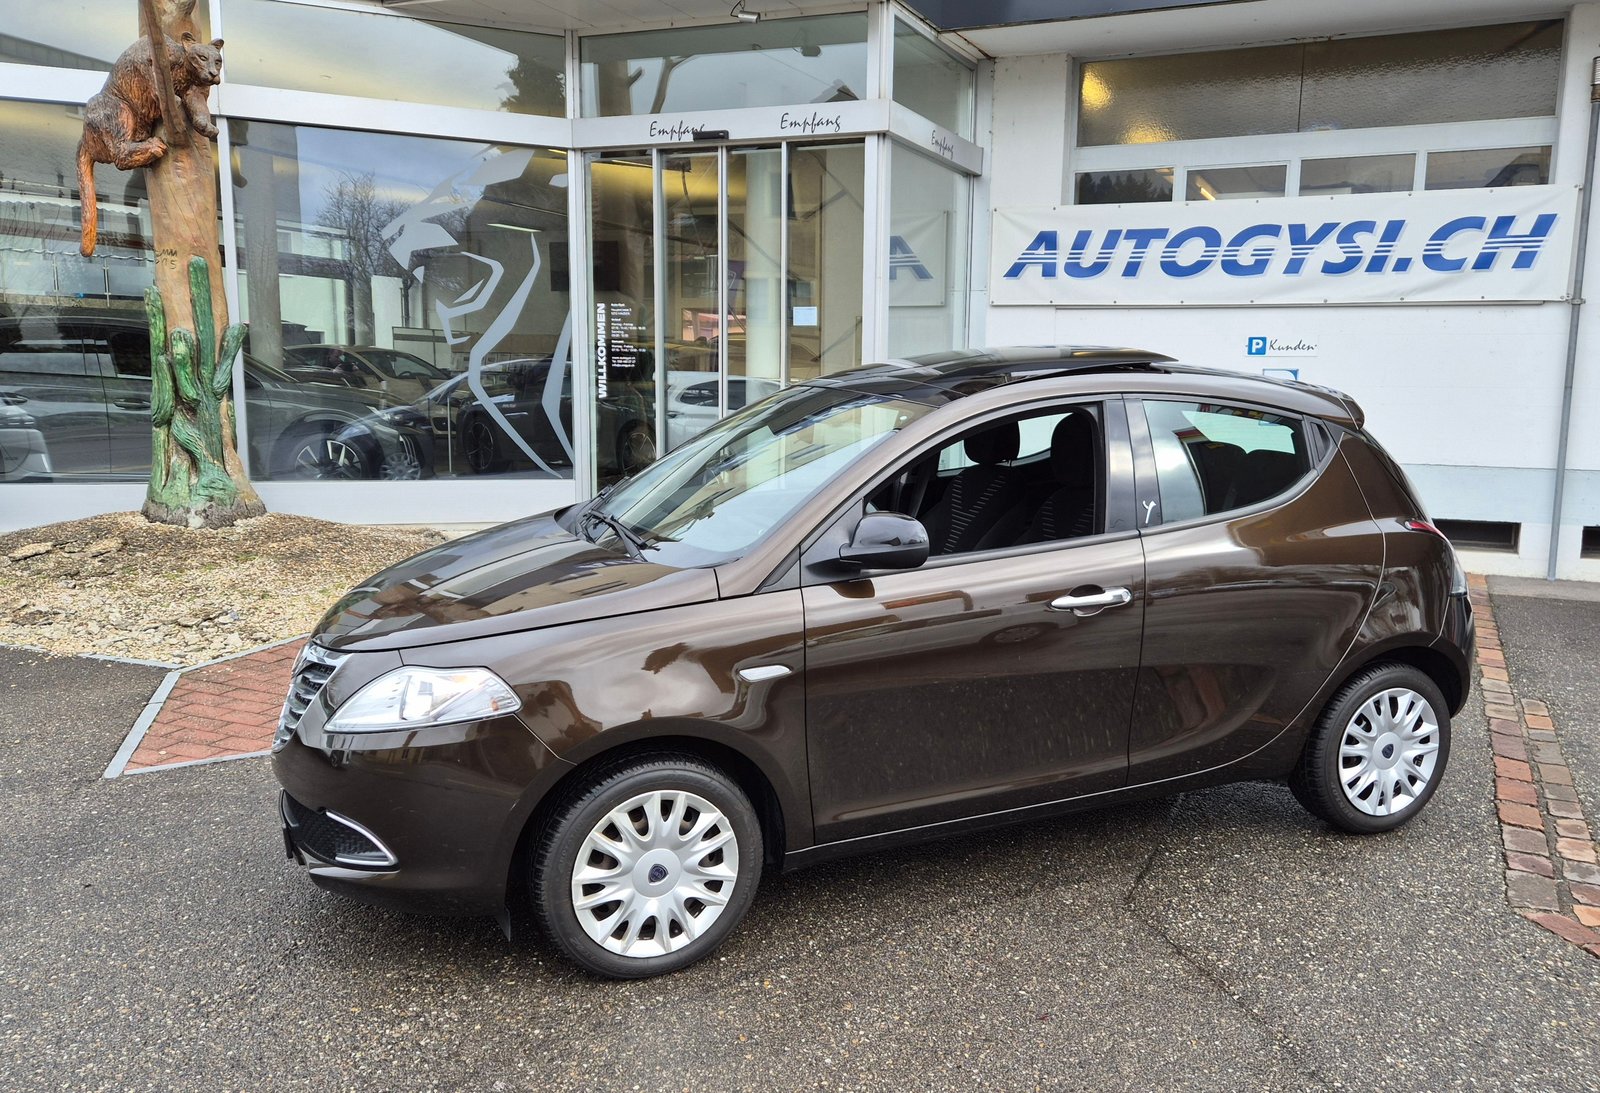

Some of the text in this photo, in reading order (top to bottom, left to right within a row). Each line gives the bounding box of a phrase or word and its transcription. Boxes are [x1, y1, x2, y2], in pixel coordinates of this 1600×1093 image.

[780, 111, 841, 133] Empfang
[1003, 213, 1559, 279] AUTOGYSI.CH
[596, 302, 607, 399] WILLKOMMEN
[1268, 338, 1315, 351] Kunden
